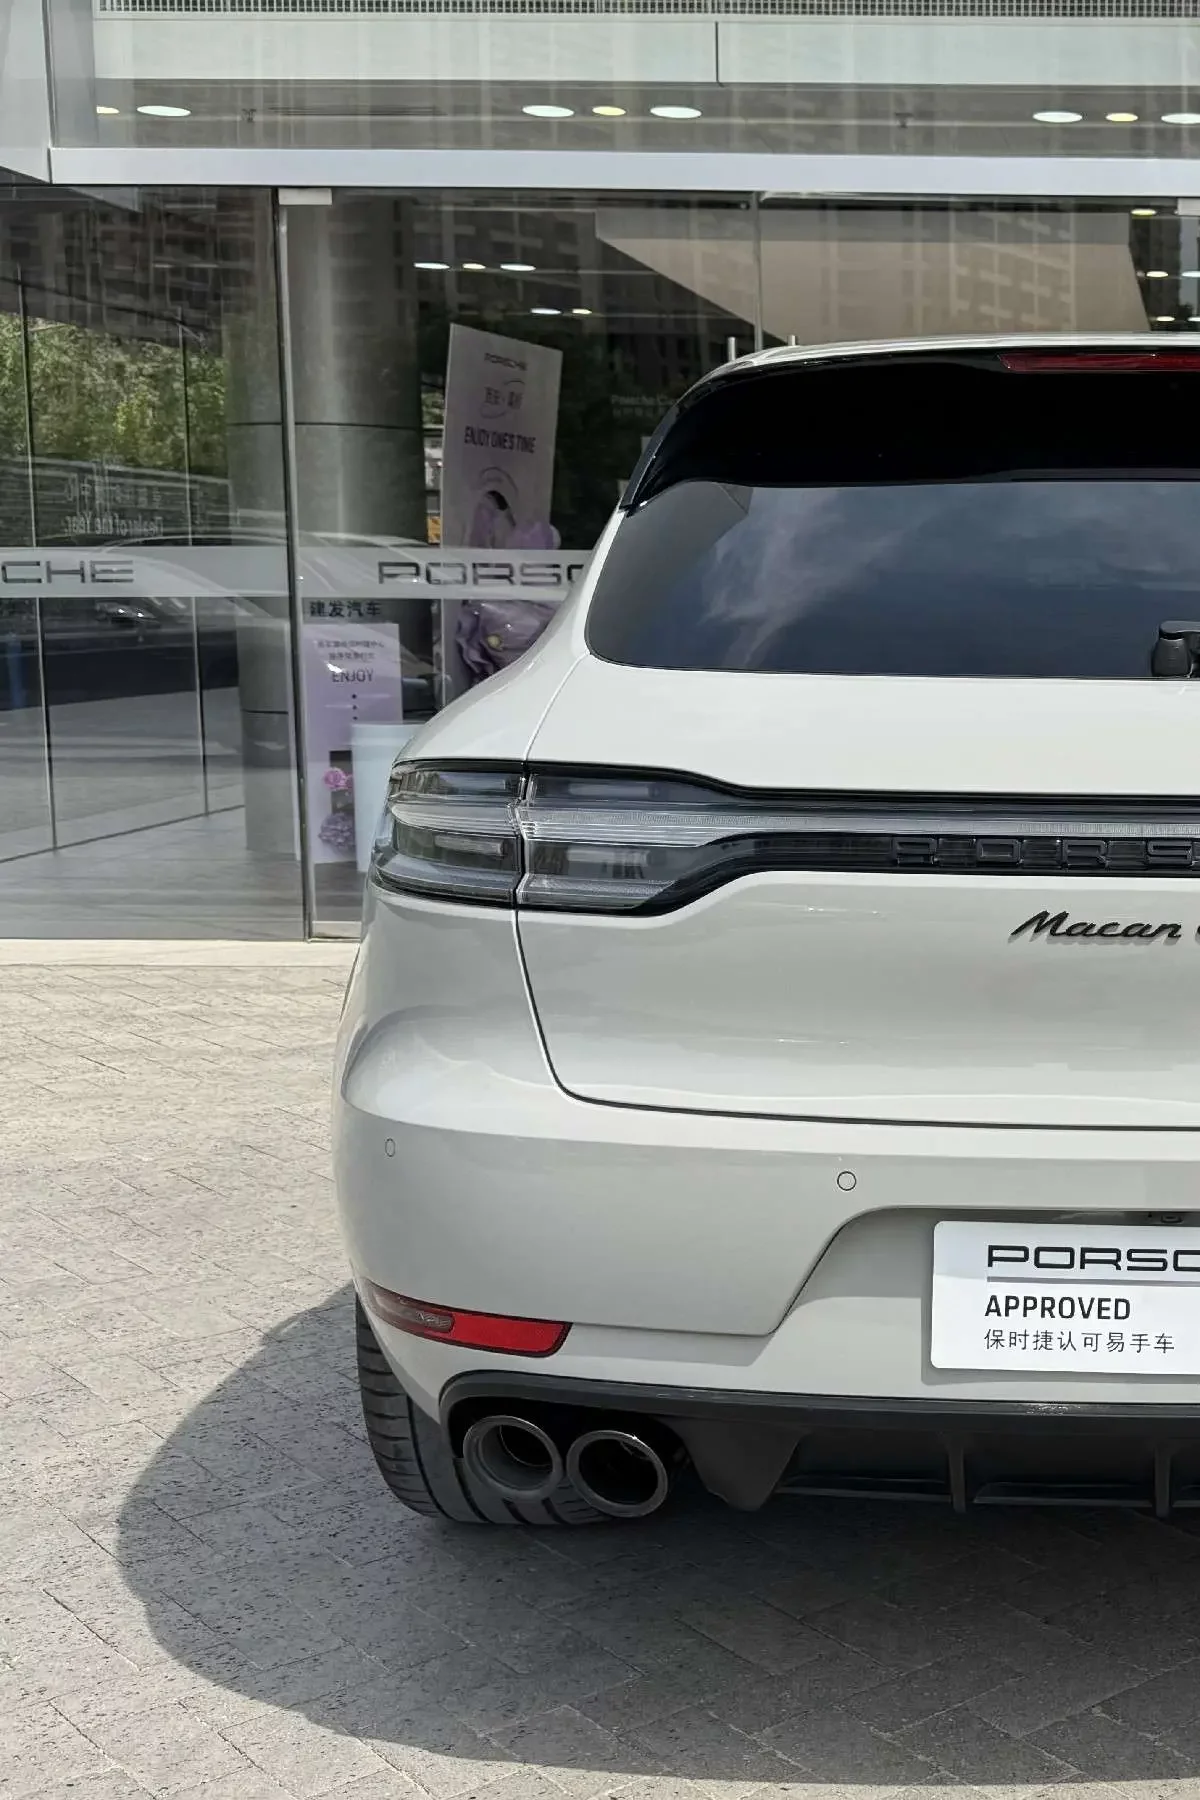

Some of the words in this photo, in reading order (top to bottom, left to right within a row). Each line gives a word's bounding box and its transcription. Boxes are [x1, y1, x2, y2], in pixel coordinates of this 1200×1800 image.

[464, 425, 489, 446] ENJOY
[310, 600, 382, 617] 建发汽车
[332, 668, 374, 682] ENJOY
[1010, 910, 1182, 938] Macan
[984, 1295, 1131, 1321] APPROVED
[983, 1328, 1176, 1354] 保时捷认可易手车
